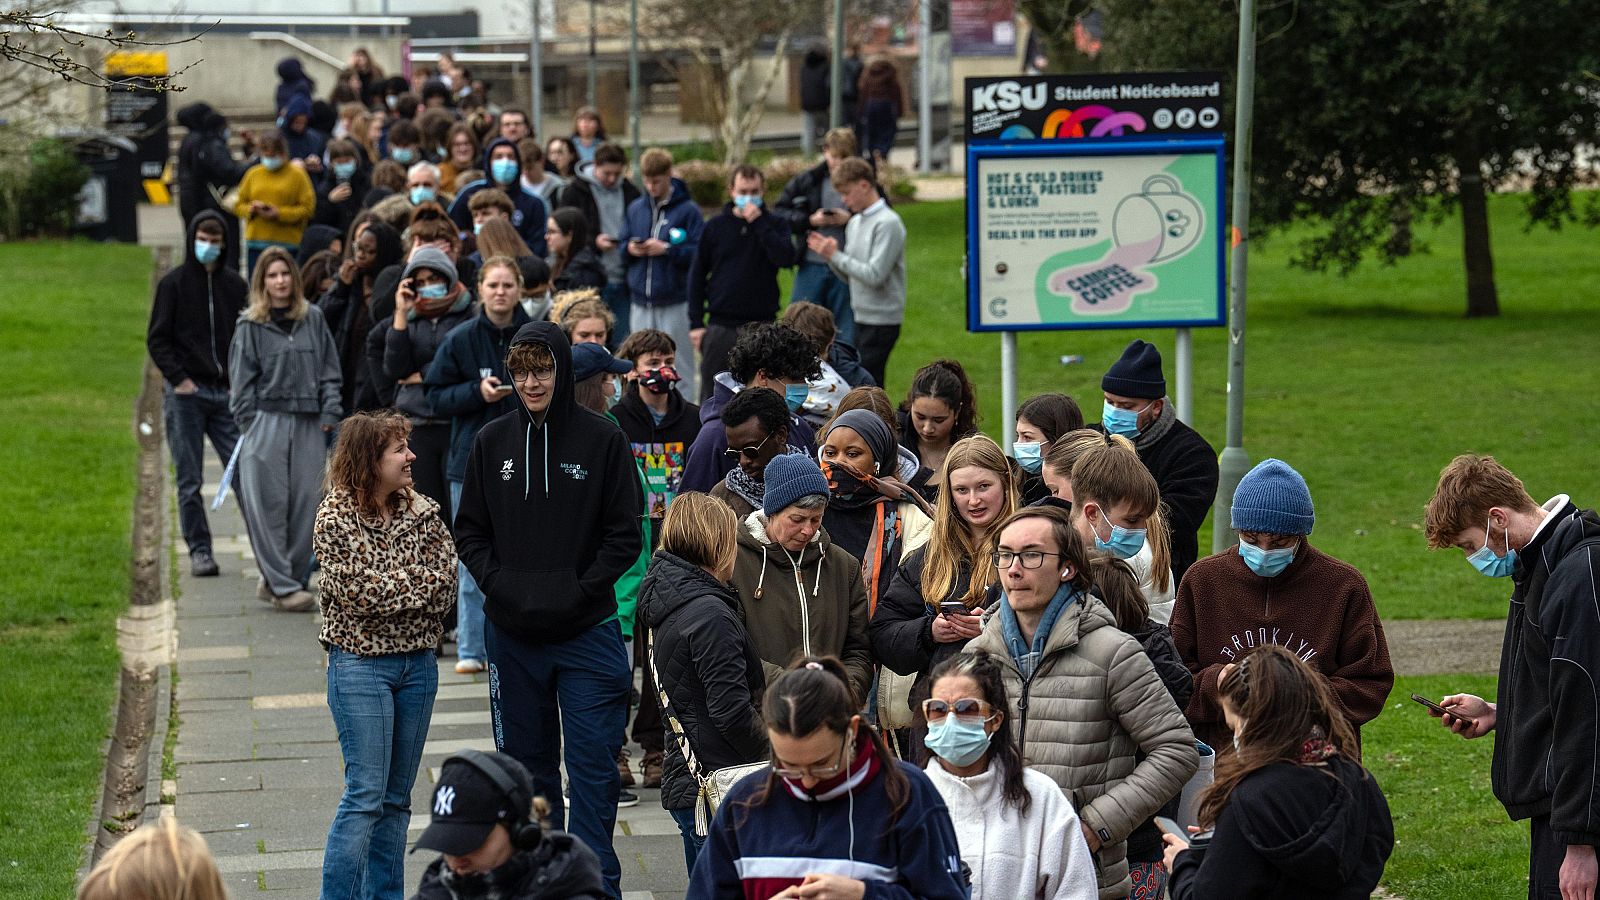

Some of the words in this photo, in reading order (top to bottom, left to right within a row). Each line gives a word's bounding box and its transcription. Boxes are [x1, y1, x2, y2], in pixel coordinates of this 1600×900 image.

[972, 80, 1048, 111] KSU
[1054, 84, 1119, 101] Student
[1120, 81, 1220, 99] Noticeboard
[987, 173, 1009, 184] HOT
[1025, 172, 1056, 183] COLD
[1040, 184, 1097, 195] PASTRIES
[1000, 197, 1038, 208] LUNCH
[988, 230, 1017, 239] DEALS
[1038, 229, 1055, 239] THE
[1067, 264, 1127, 291] CAMPUS
[1081, 272, 1143, 304] COFFEE
[560, 462, 580, 470] MILANO
[434, 785, 456, 815] NY
